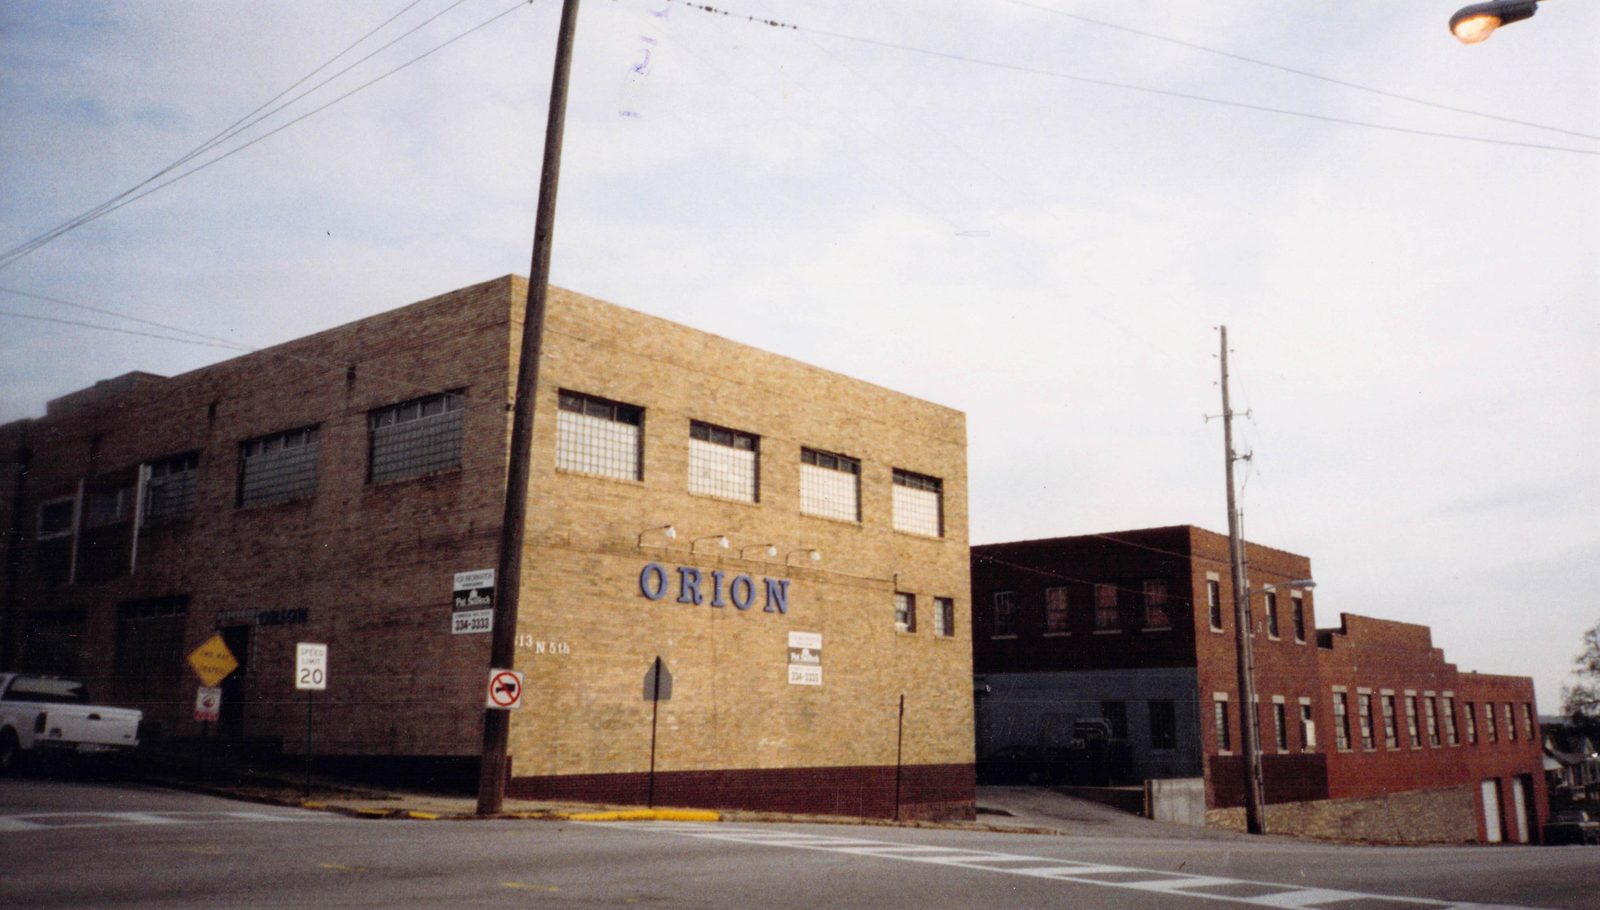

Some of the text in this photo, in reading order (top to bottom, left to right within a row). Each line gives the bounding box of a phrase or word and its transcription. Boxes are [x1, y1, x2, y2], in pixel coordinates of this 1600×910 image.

[640, 562, 790, 614] ORION
[455, 617, 490, 631] 334-3333
[301, 647, 324, 656] SPEED
[536, 641, 545, 654] N
[549, 642, 570, 656] 5th
[300, 668, 323, 684] 20
